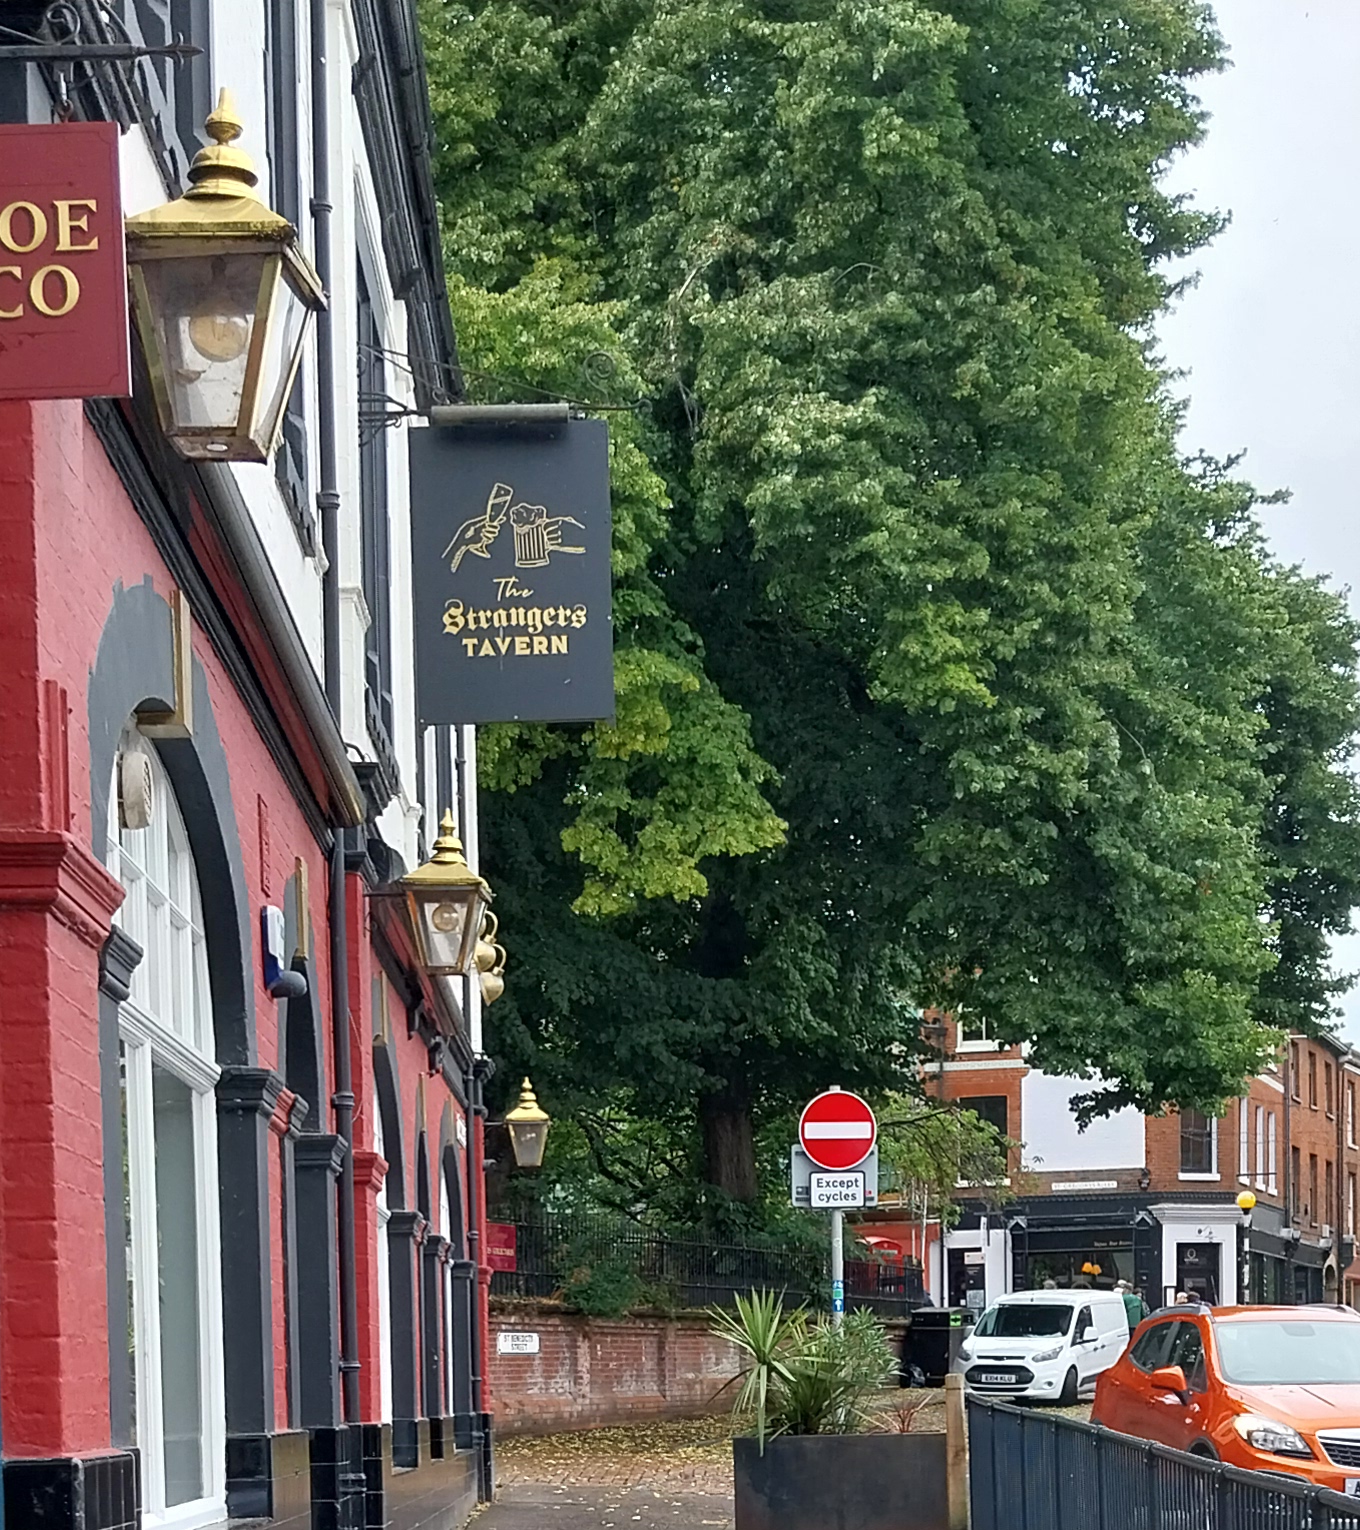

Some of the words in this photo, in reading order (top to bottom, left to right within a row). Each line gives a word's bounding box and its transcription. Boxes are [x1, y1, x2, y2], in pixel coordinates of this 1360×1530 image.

[492, 575, 534, 602] The
[442, 598, 588, 636] Strangers
[461, 634, 569, 658] TAVERN
[816, 1177, 859, 1190] Except
[818, 1190, 857, 1204] cycles
